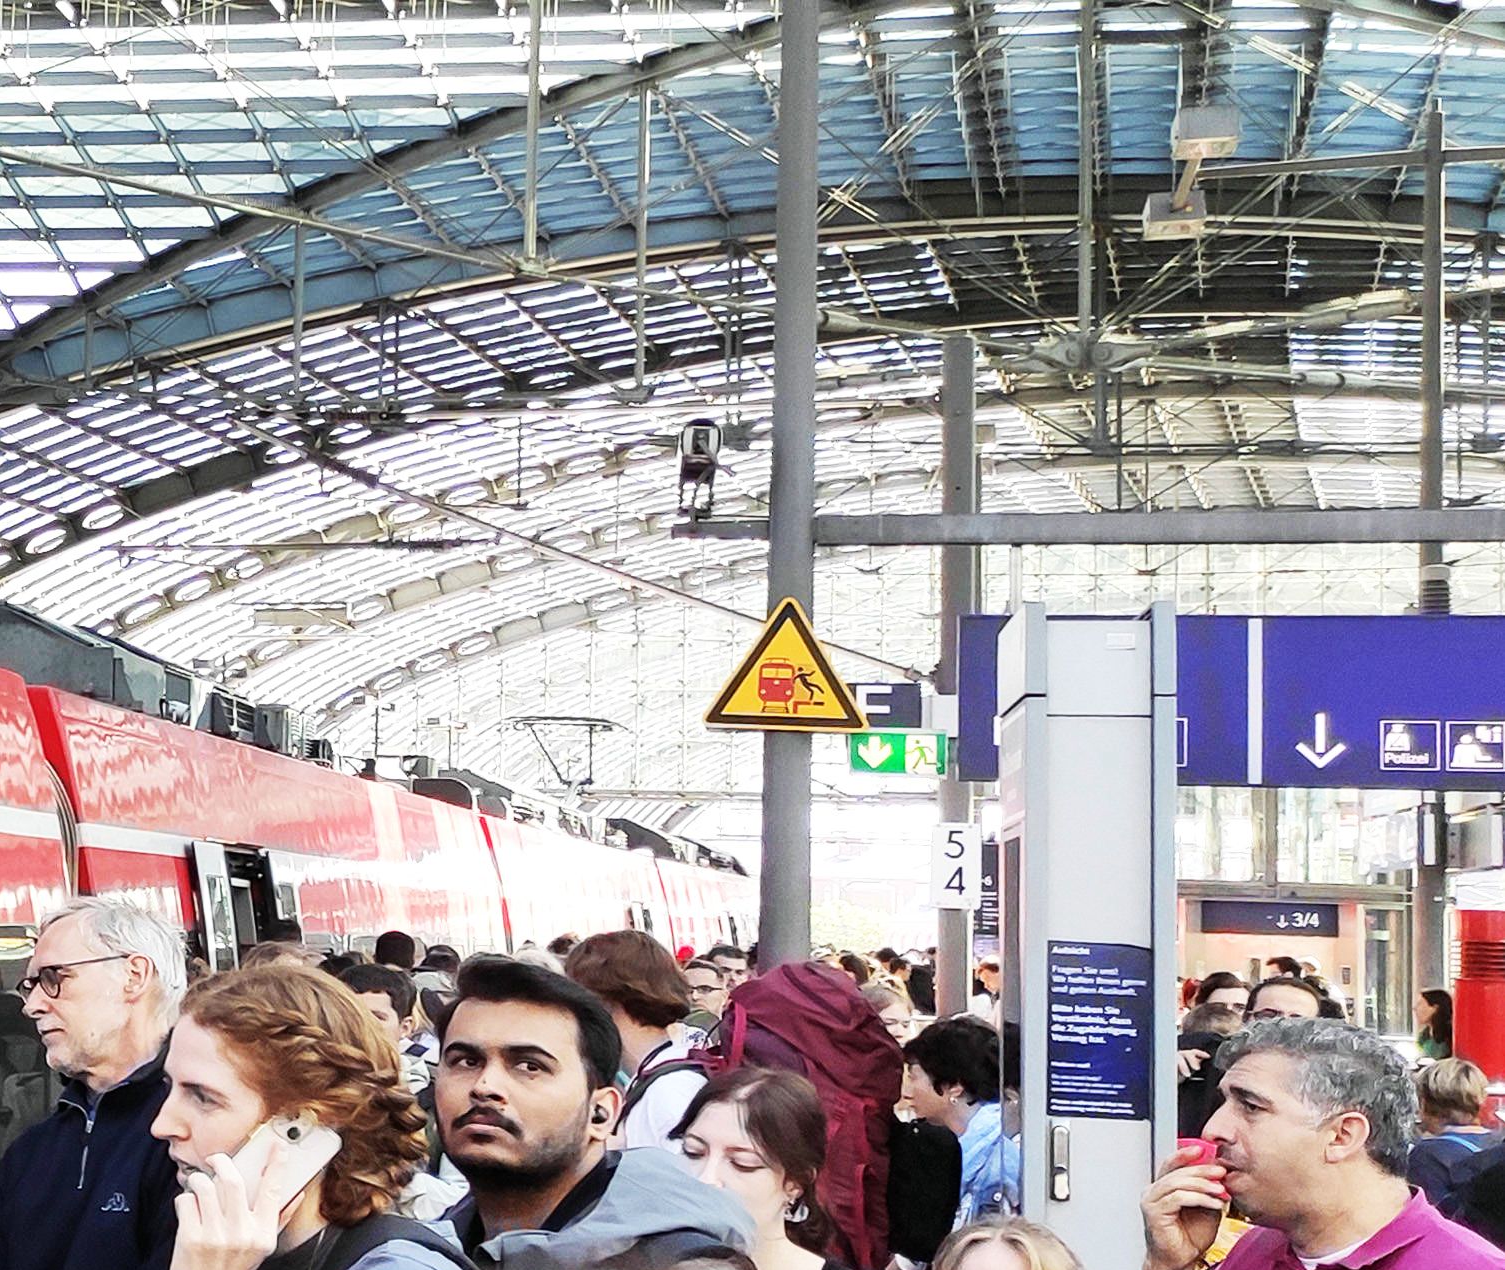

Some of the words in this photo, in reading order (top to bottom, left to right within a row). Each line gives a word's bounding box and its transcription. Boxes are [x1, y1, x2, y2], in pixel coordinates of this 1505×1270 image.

[1384, 752, 1430, 765] Polizei
[944, 830, 965, 859] 5
[943, 866, 966, 896] 4
[1291, 912, 1320, 928] 3/4
